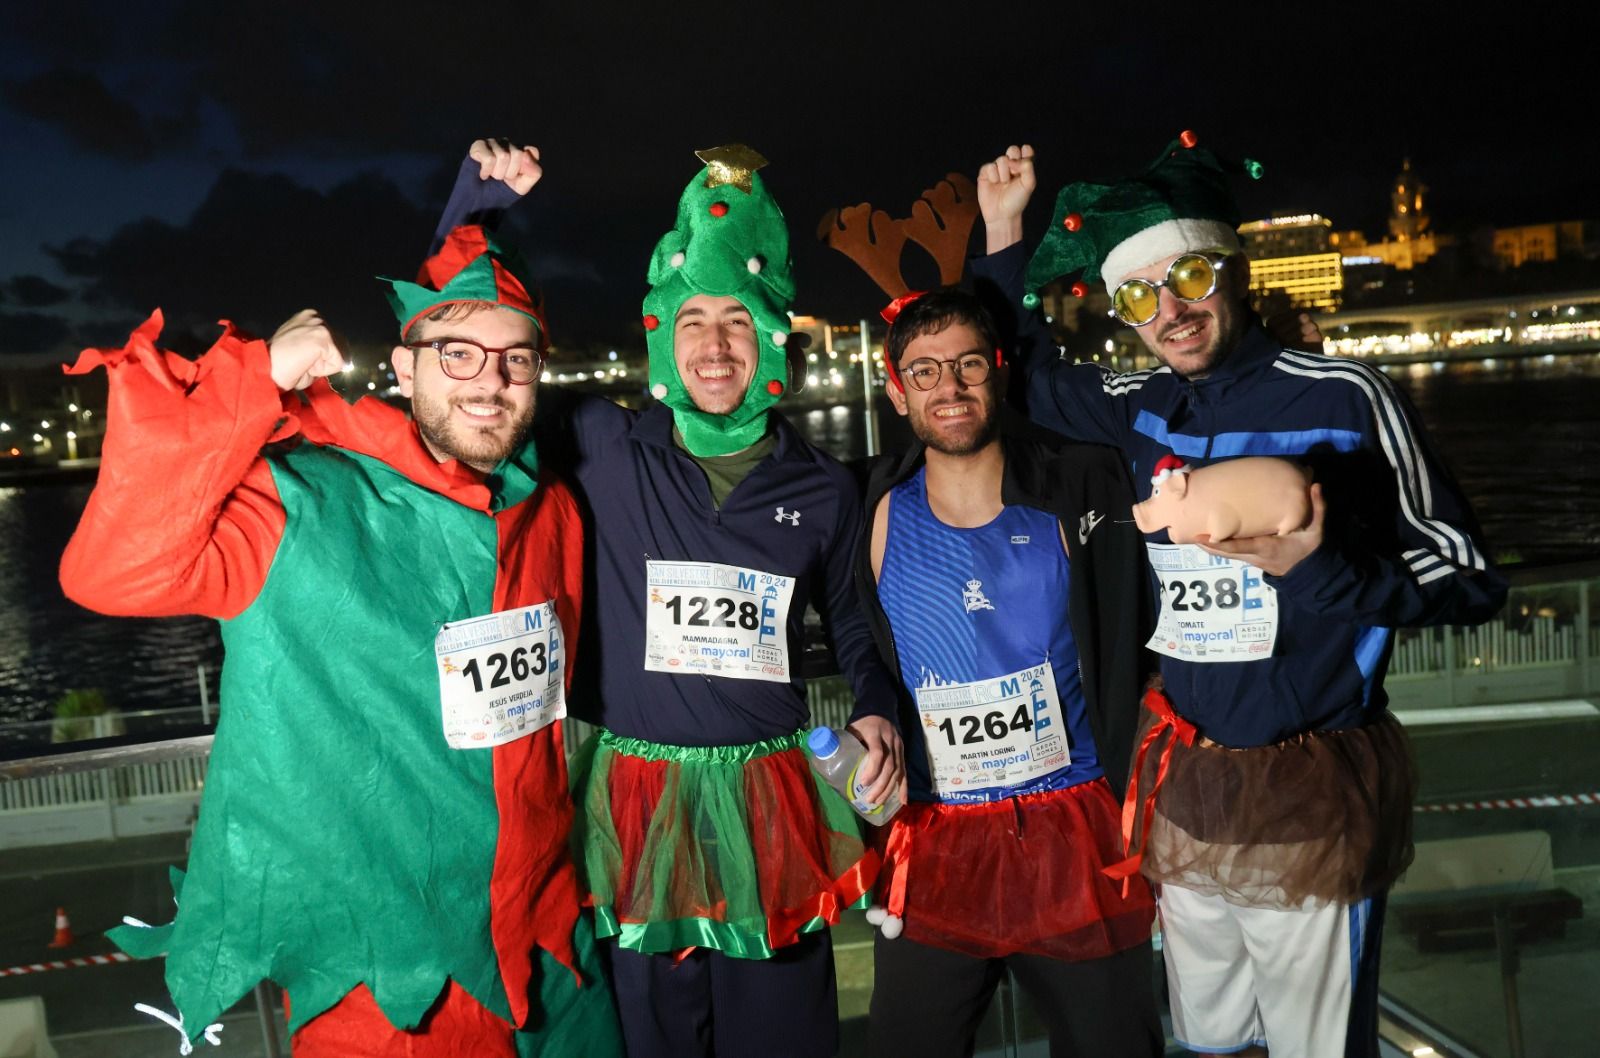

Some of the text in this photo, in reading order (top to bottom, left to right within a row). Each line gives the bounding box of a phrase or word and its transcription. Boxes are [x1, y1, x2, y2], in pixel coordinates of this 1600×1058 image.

[665, 595, 760, 631] 1228
[1184, 629, 1233, 643] mayoral
[701, 646, 750, 659] mayoral
[462, 642, 547, 693] 1263
[509, 689, 534, 703] VERDEJA
[507, 696, 543, 718] mayoral
[938, 703, 1034, 746] 1264
[982, 751, 1030, 770] mayoral
[990, 746, 1016, 757] LORING
